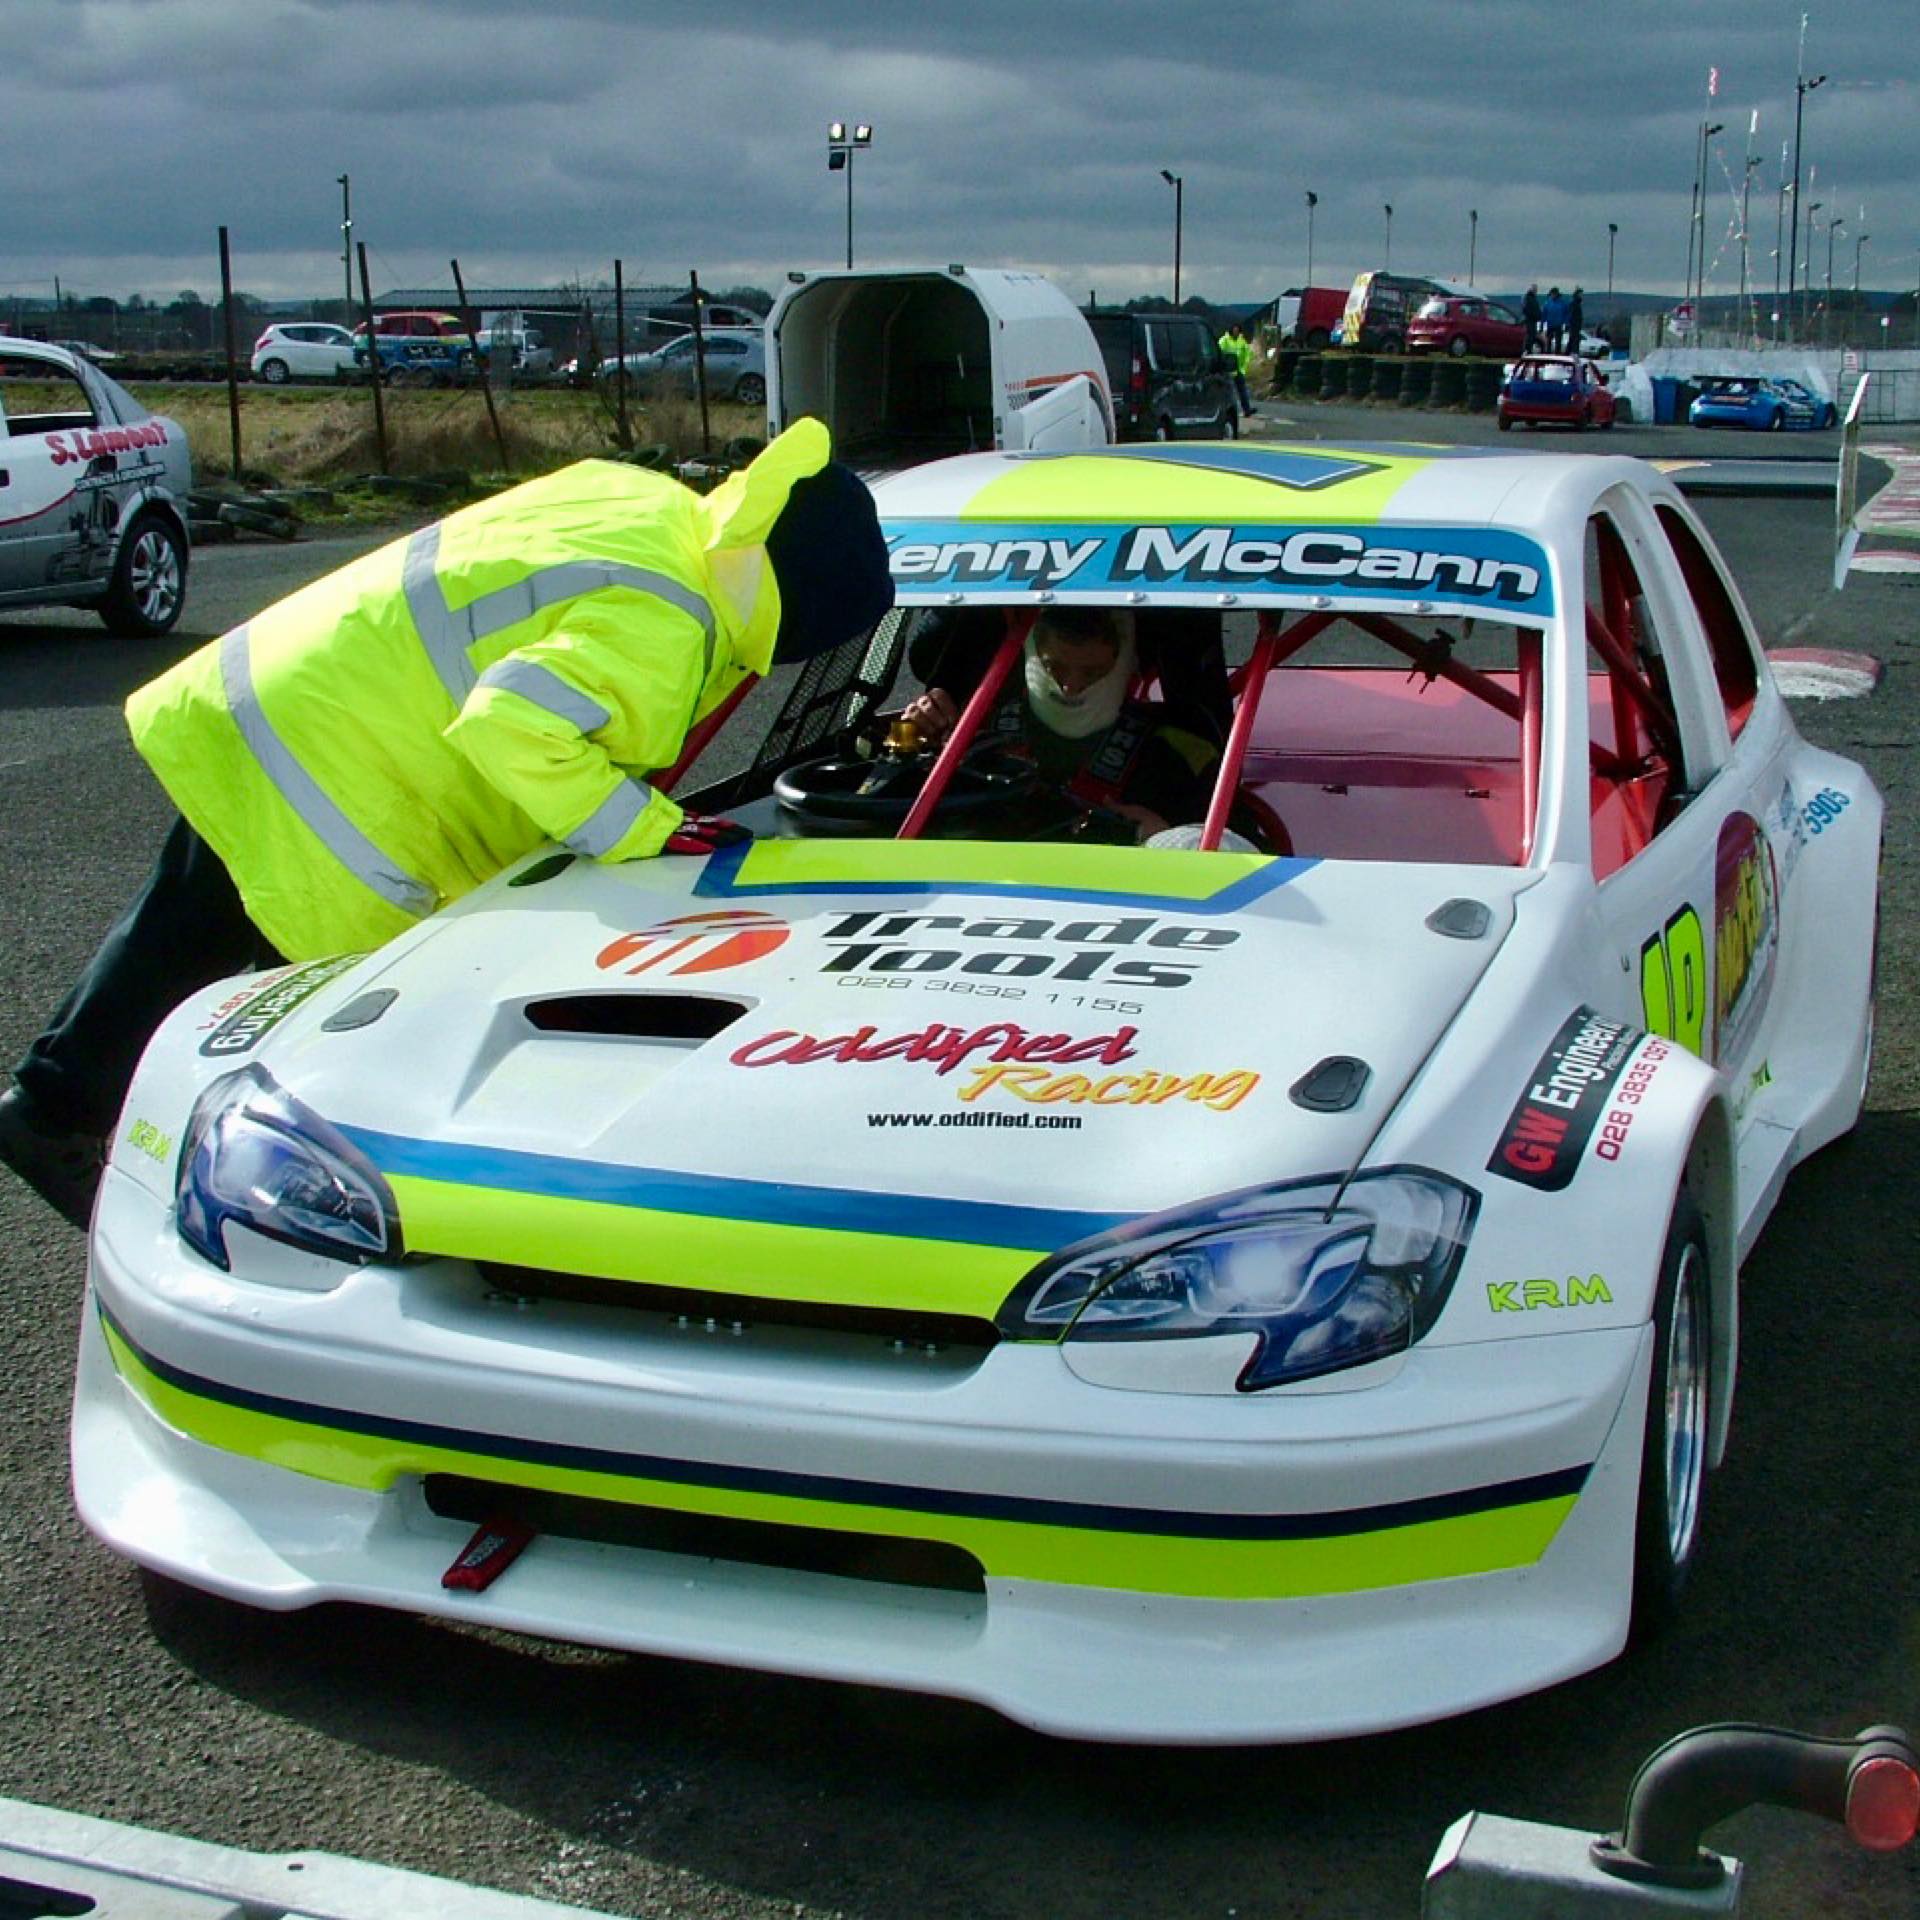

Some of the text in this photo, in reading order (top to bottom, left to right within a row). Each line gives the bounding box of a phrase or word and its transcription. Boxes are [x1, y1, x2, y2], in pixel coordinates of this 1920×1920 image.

[884, 527, 1540, 598] enny McCann
[820, 910, 1242, 950] Trade
[818, 942, 1202, 988] Tools
[837, 975, 1145, 1015] 028 3832 1155
[729, 1022, 1140, 1076] Oddified
[1530, 1014, 1623, 1110] Engineeri
[957, 1065, 1260, 1111] Racing
[1596, 1109, 1634, 1161] 028
[1617, 1061, 1659, 1105] 3835
[867, 1112, 1083, 1130] www.oddified.com
[1503, 1106, 1570, 1173] GW
[1486, 1273, 1613, 1312] KRM
